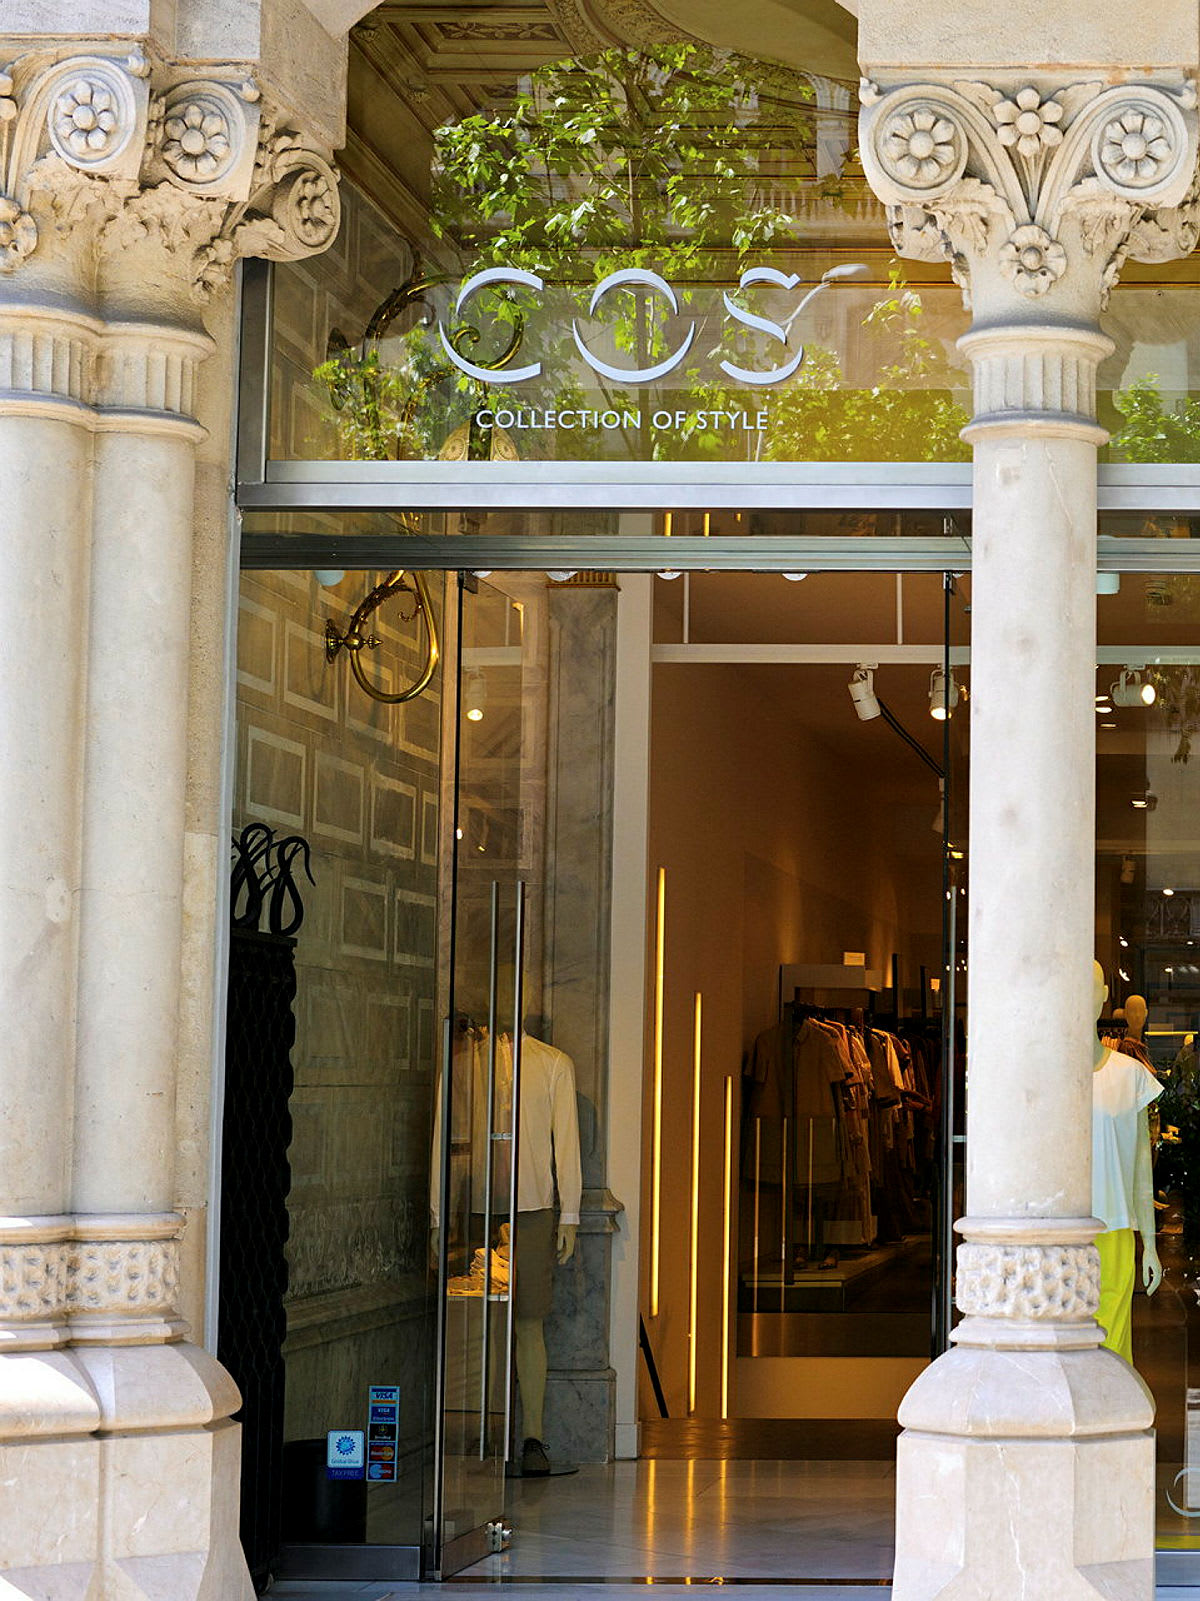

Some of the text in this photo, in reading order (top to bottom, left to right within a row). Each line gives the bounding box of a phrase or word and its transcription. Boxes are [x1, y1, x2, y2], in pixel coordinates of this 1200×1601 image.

[438, 267, 803, 384] COS
[475, 409, 769, 430] COLLECTION OF STYLE
[375, 1391, 393, 1400] VISA
